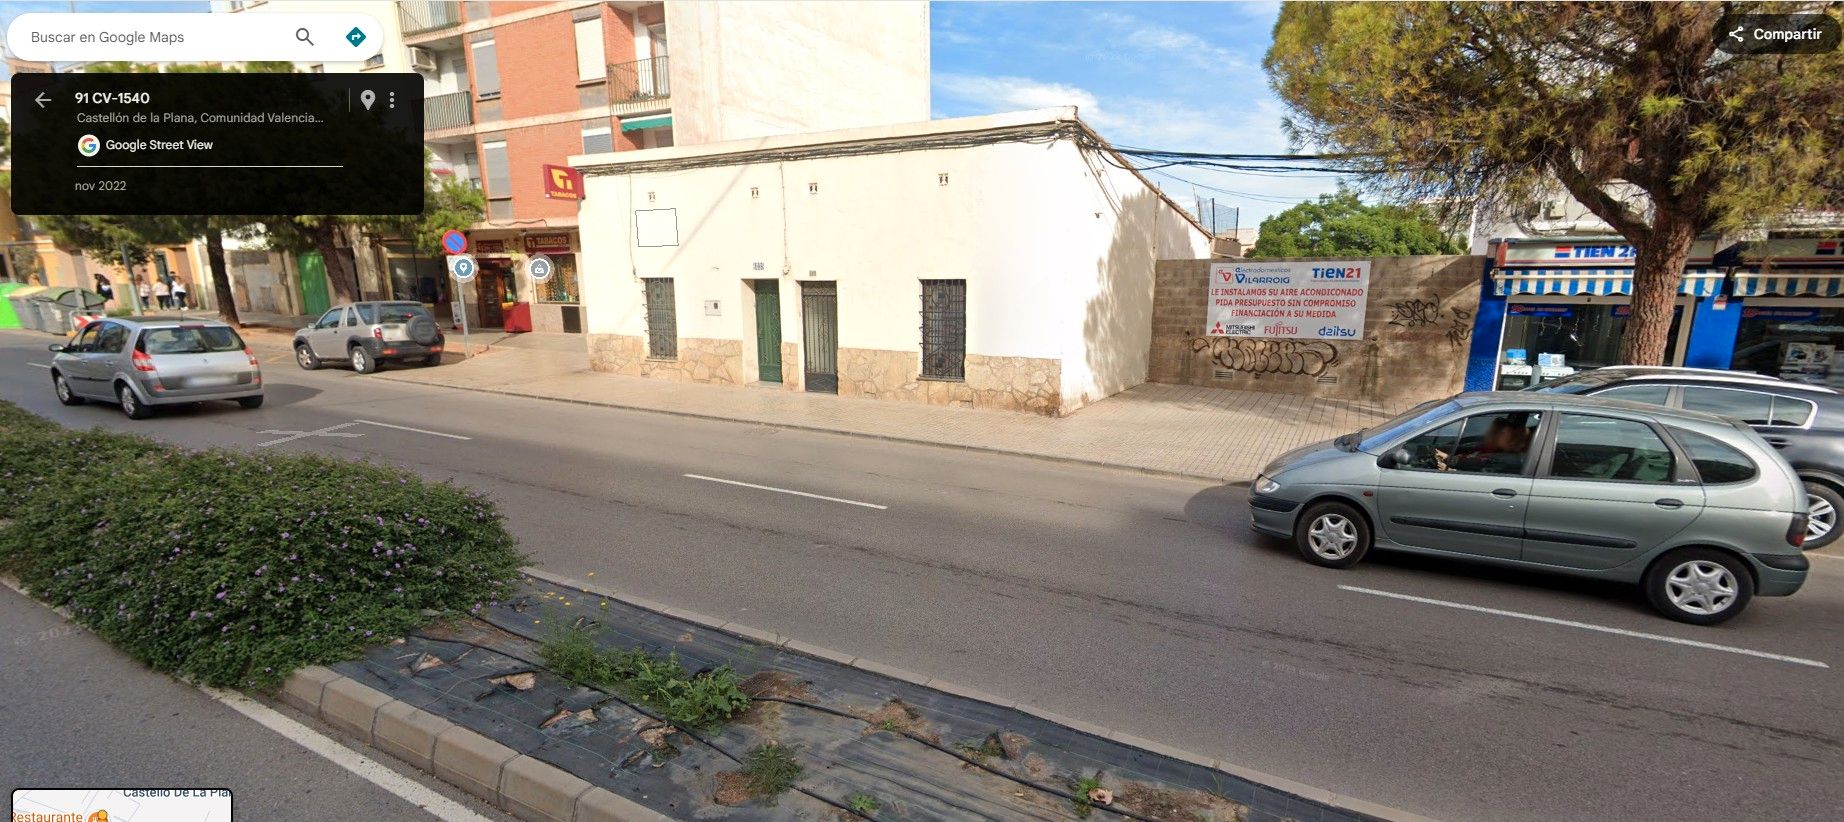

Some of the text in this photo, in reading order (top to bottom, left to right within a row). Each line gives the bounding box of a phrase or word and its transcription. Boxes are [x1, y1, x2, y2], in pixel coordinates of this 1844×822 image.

[550, 191, 578, 199] TABACOS
[536, 236, 567, 245] TABACOS
[1574, 245, 1617, 258] TIEN
[1211, 288, 1219, 296] LE
[1220, 288, 1267, 296] INSTALAMOS
[1280, 288, 1299, 296] AIRE
[1300, 288, 1364, 297] ACONDICONADO
[1234, 299, 1286, 307] PRESUPUESTO
[1287, 299, 1301, 307] SIN
[1303, 299, 1357, 308] COMPROMISO
[1231, 308, 1285, 317] FINANCIACIÓN
[1305, 310, 1337, 318] MEDIDA
[1263, 321, 1298, 337] FUJITSU
